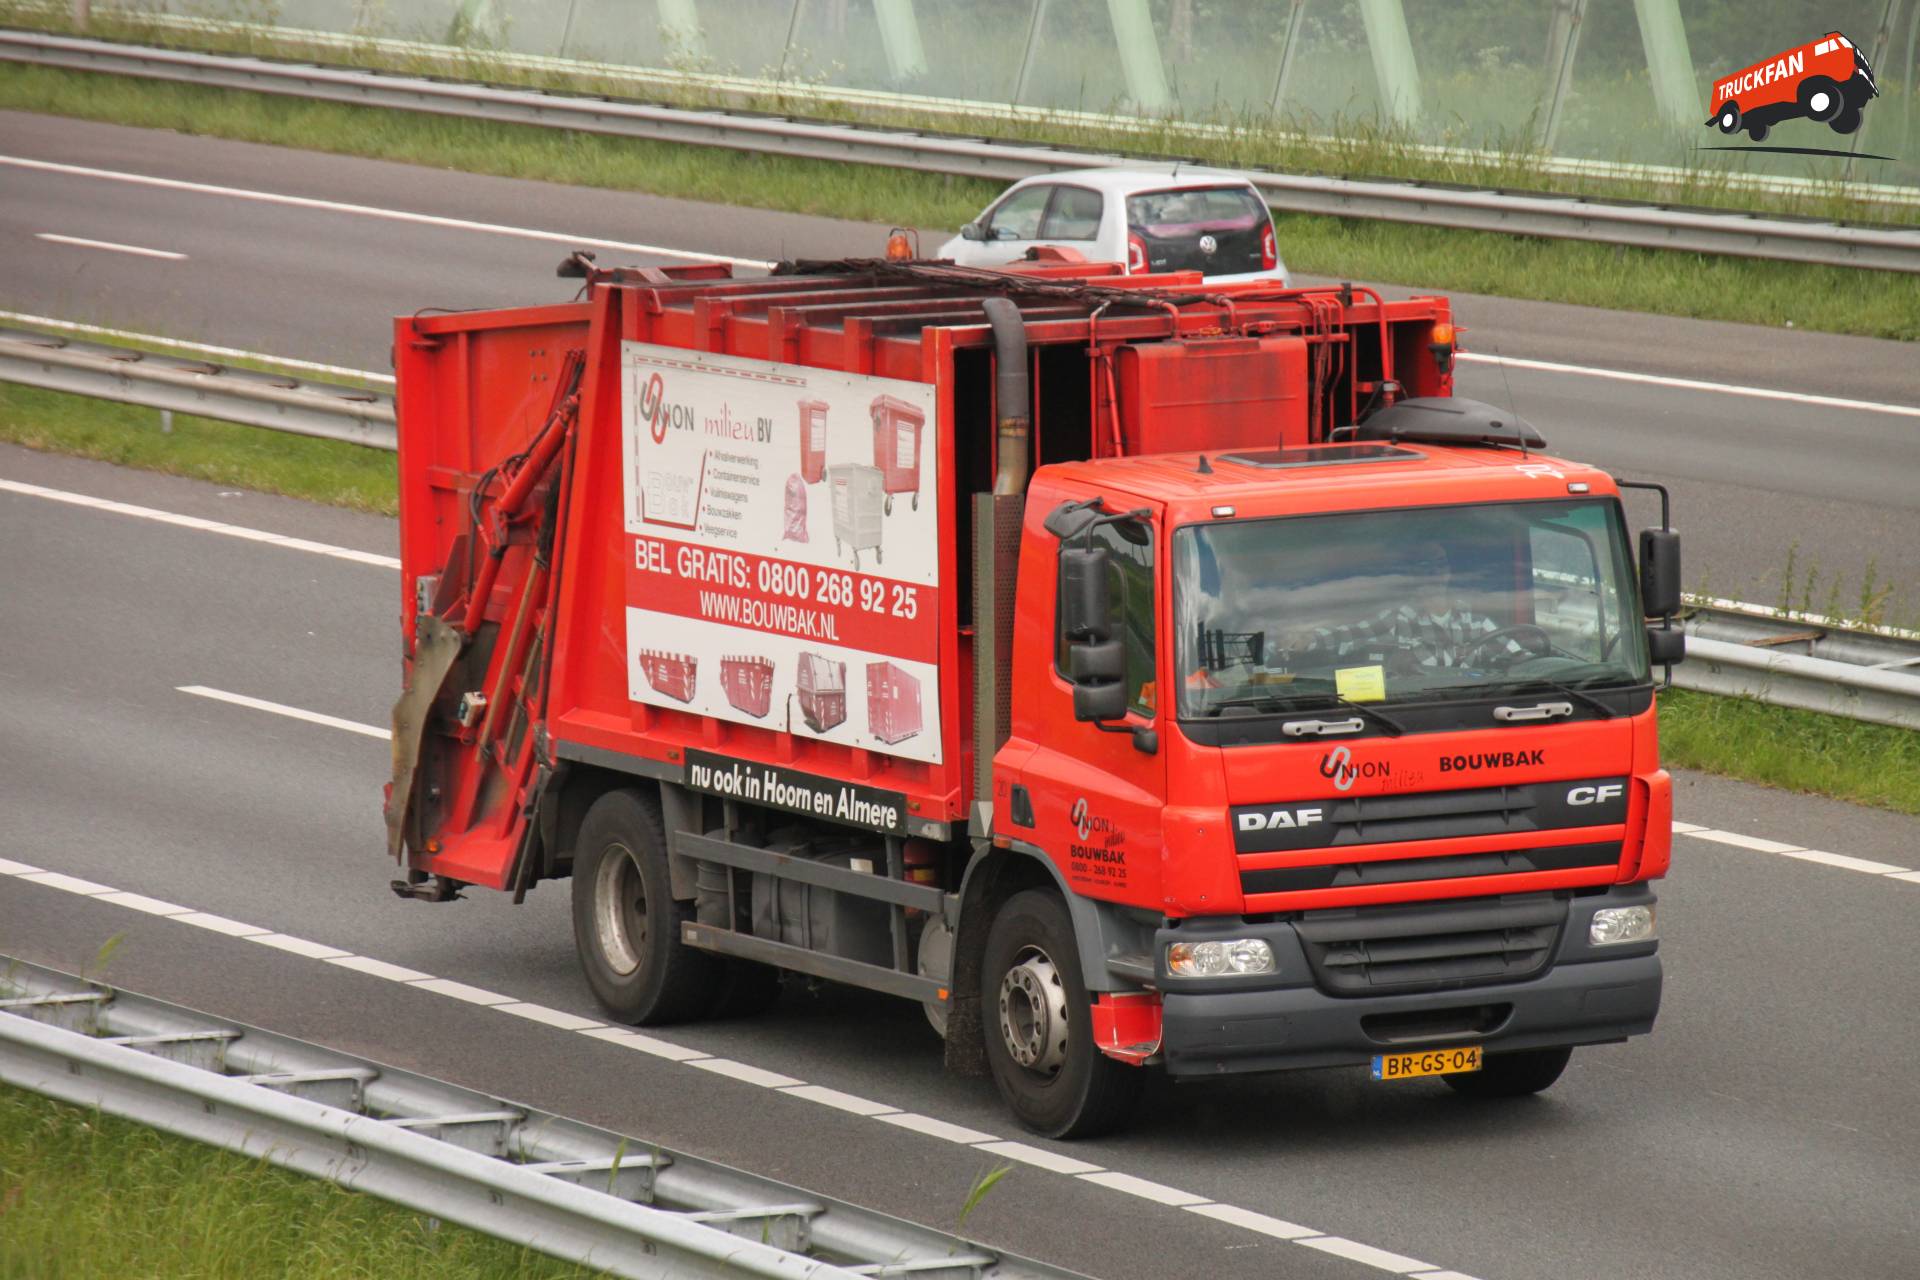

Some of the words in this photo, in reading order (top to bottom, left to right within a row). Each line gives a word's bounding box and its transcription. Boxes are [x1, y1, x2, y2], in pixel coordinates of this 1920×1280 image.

[704, 401, 754, 442] milieu
[757, 417, 772, 443] BV
[635, 539, 672, 575] BEL
[677, 546, 751, 589] GRATIS:
[758, 560, 810, 599] 0800
[816, 571, 854, 607] 268
[860, 580, 885, 614] 92
[891, 586, 918, 620] 25
[700, 590, 839, 641] WWW.BOUWBAK.NL
[1320, 750, 1390, 784] UNION
[1439, 749, 1545, 773] BOUWBAK
[691, 764, 710, 788] nu
[713, 763, 743, 796] ook
[745, 766, 760, 800] in
[763, 770, 811, 811] Hoorn
[814, 791, 833, 815] en
[836, 787, 898, 829] Almere
[1566, 784, 1623, 806] CF
[1238, 808, 1323, 831] DAF
[1070, 845, 1125, 865] BOUWBAK
[1388, 1050, 1477, 1076] BR-GS-04
